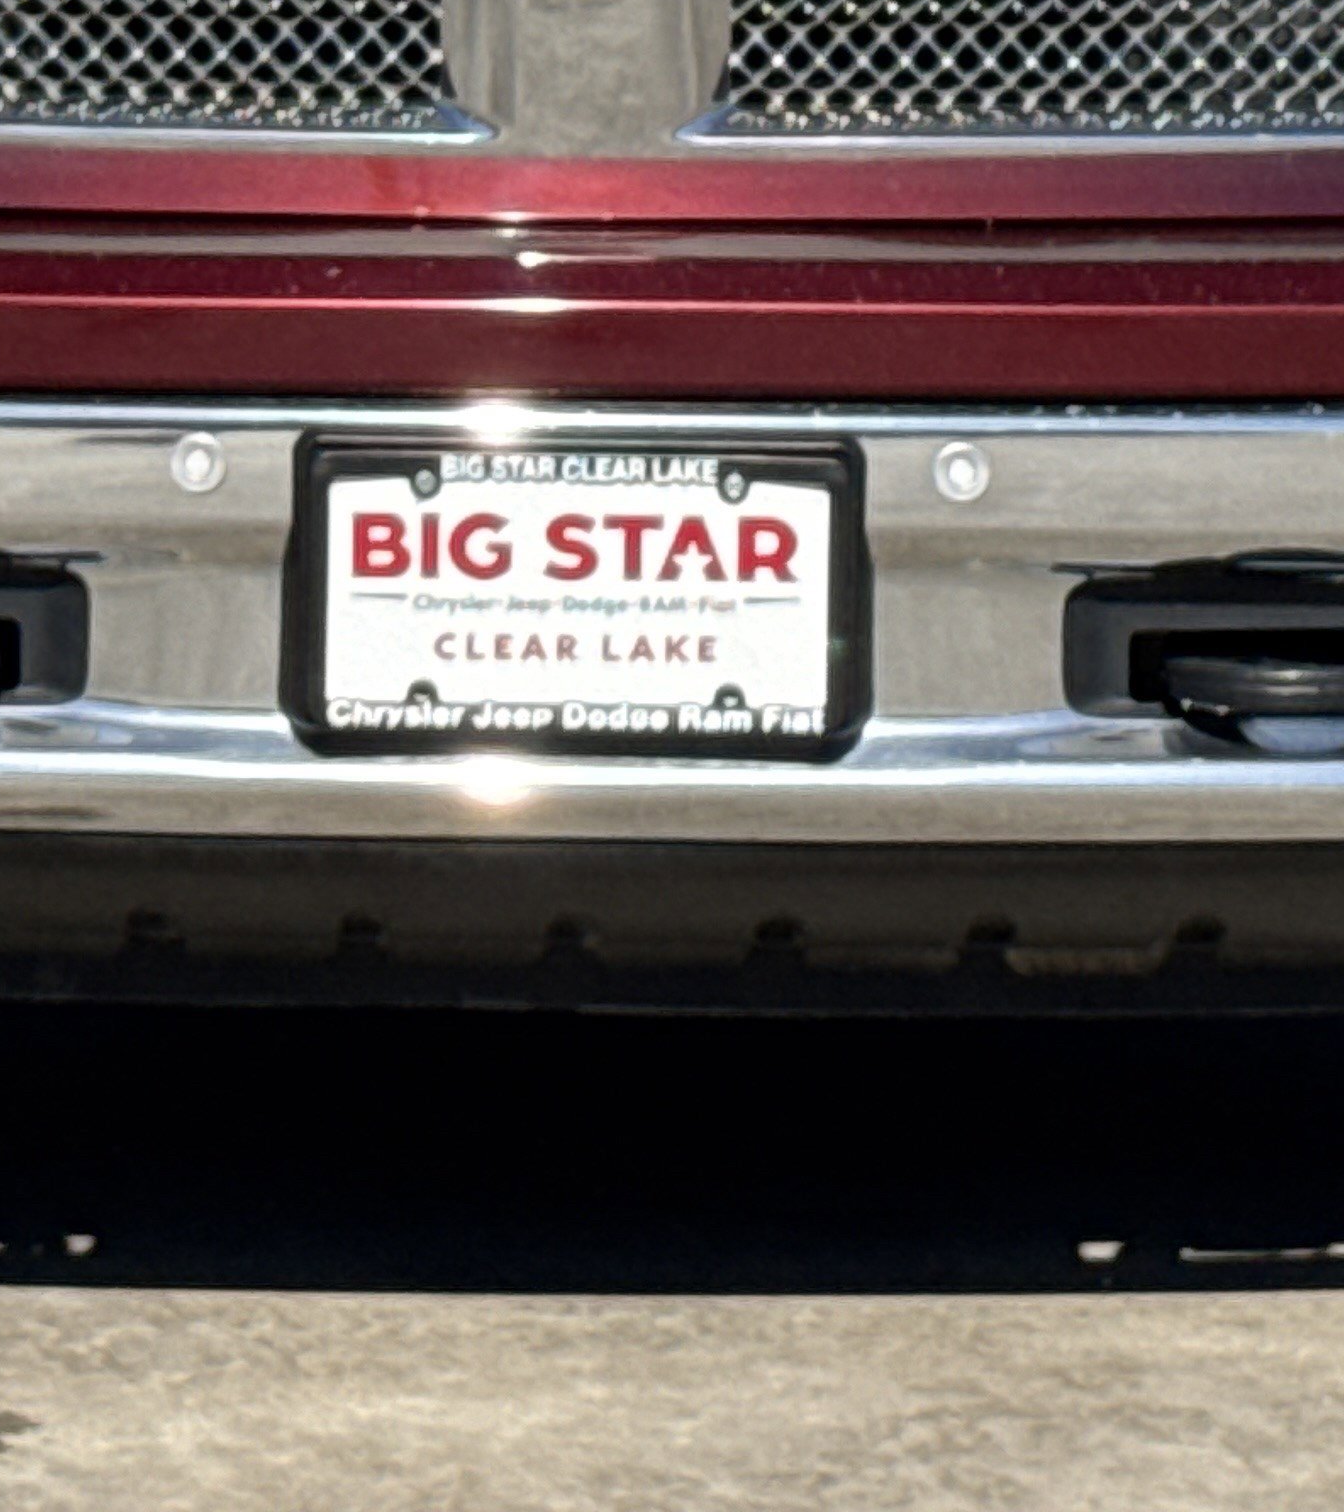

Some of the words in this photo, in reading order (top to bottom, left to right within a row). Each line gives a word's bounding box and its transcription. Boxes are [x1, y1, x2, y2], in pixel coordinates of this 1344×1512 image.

[439, 454, 484, 480] BIG
[490, 455, 555, 481] STAR
[561, 455, 646, 483] CLEAR
[651, 456, 719, 484] LAKE
[351, 512, 513, 580] BIG
[543, 514, 798, 583] STAR
[433, 631, 578, 662] CLEAR
[601, 633, 718, 664] LAKE
[326, 696, 466, 731] Chrysler
[471, 699, 555, 731] Jeep
[561, 700, 670, 733] Dodge
